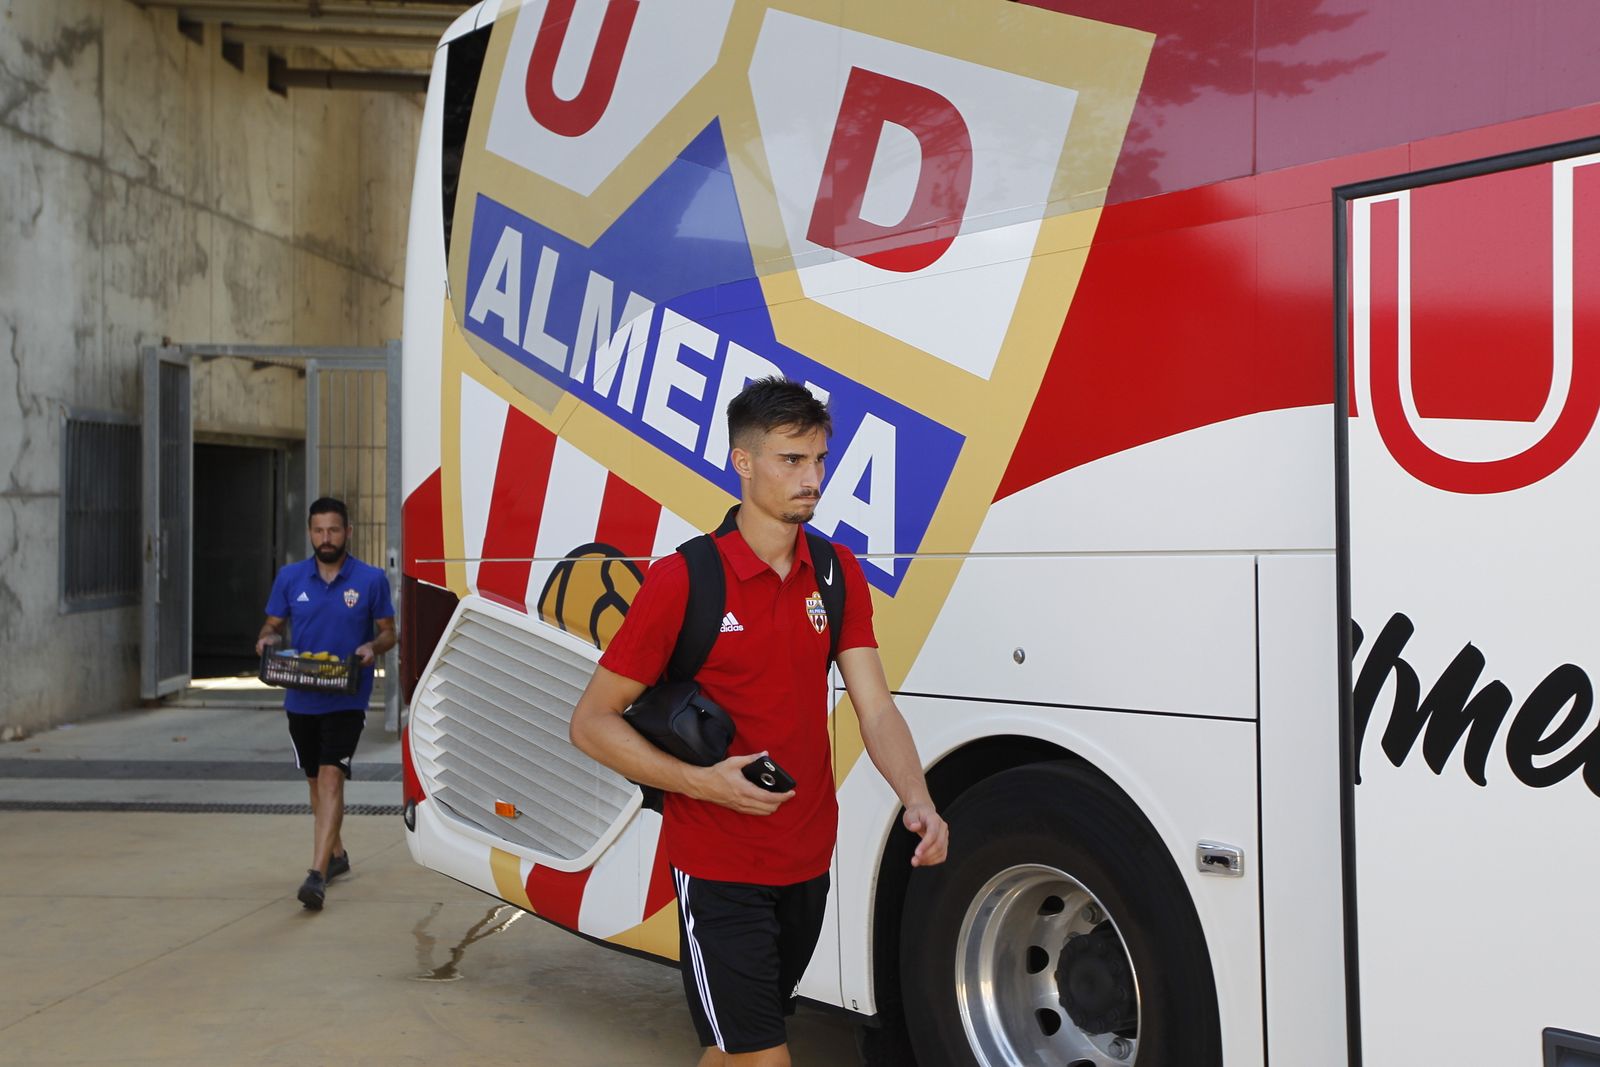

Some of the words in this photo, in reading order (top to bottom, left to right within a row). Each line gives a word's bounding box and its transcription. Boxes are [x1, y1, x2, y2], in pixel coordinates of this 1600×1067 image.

[525, 0, 641, 137] U
[806, 66, 973, 273] D
[720, 624, 744, 633] didas
